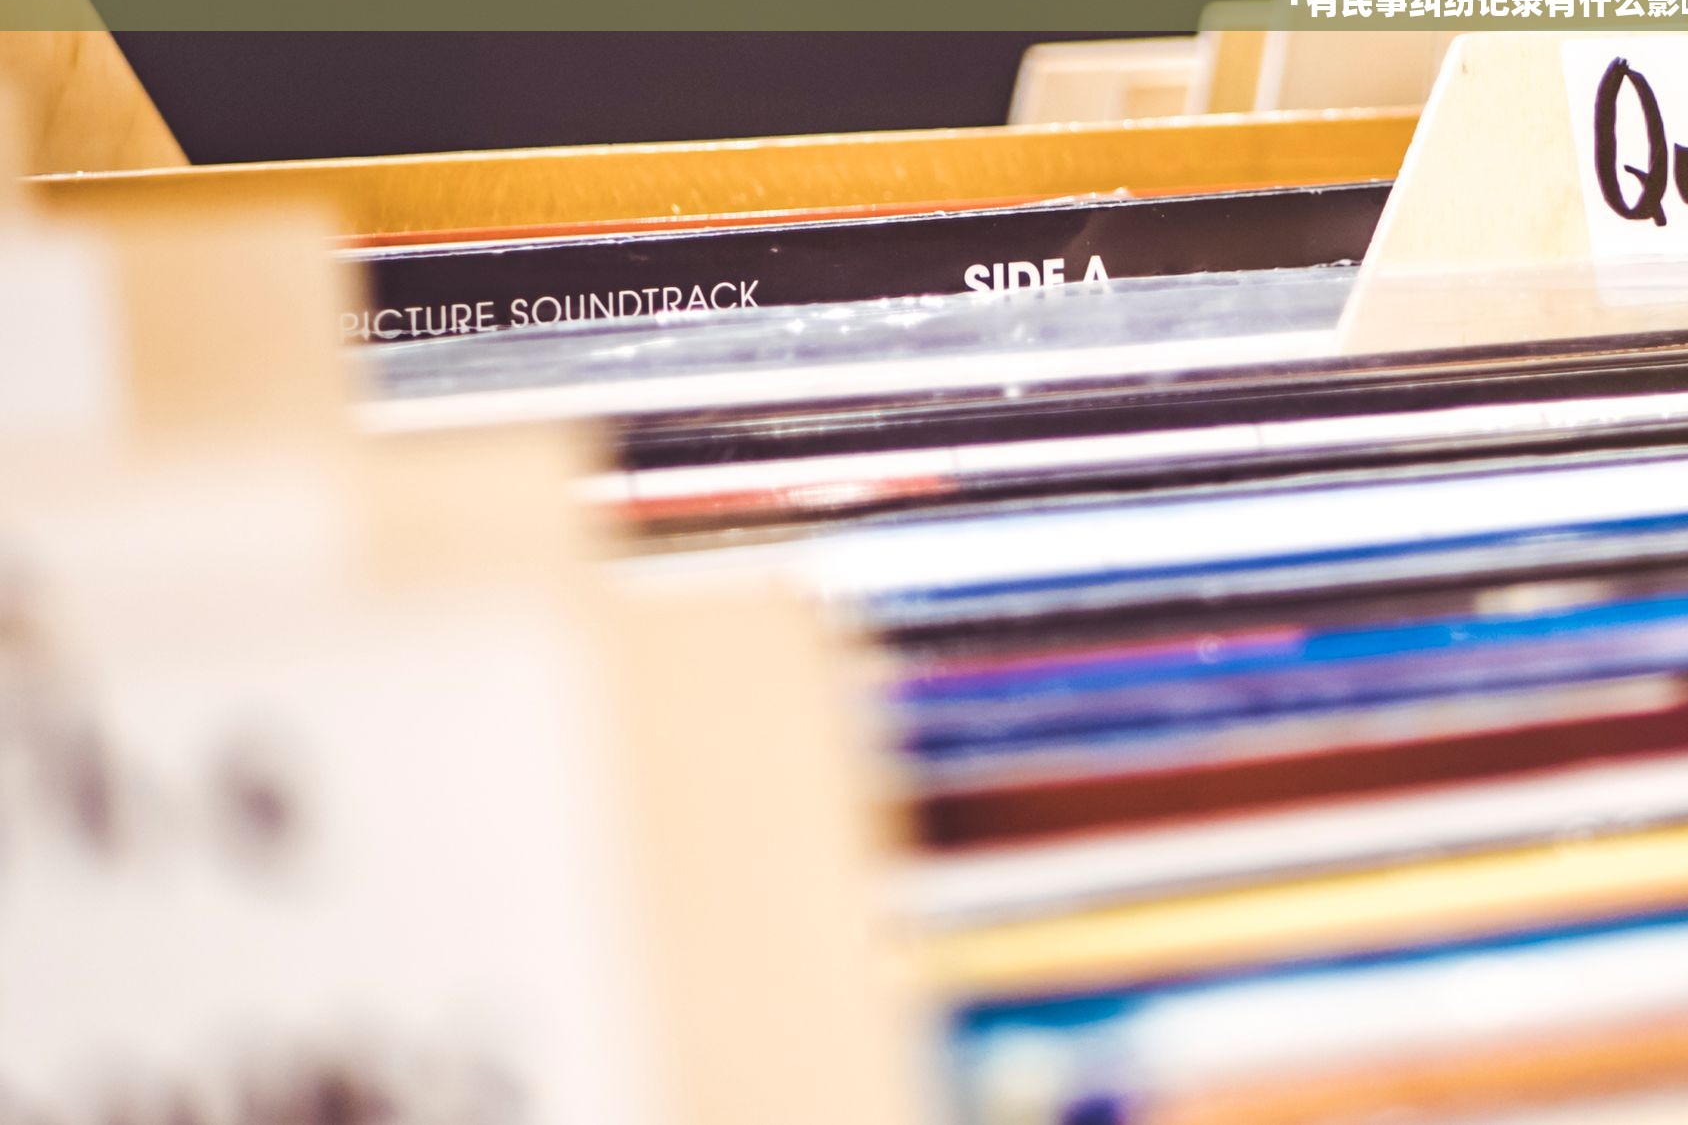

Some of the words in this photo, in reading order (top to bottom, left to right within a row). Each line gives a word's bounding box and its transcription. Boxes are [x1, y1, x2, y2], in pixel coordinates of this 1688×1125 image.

[1082, 255, 1110, 284] A
[340, 301, 495, 341] PICTURE
[510, 280, 760, 328] SOUNDTRACK
